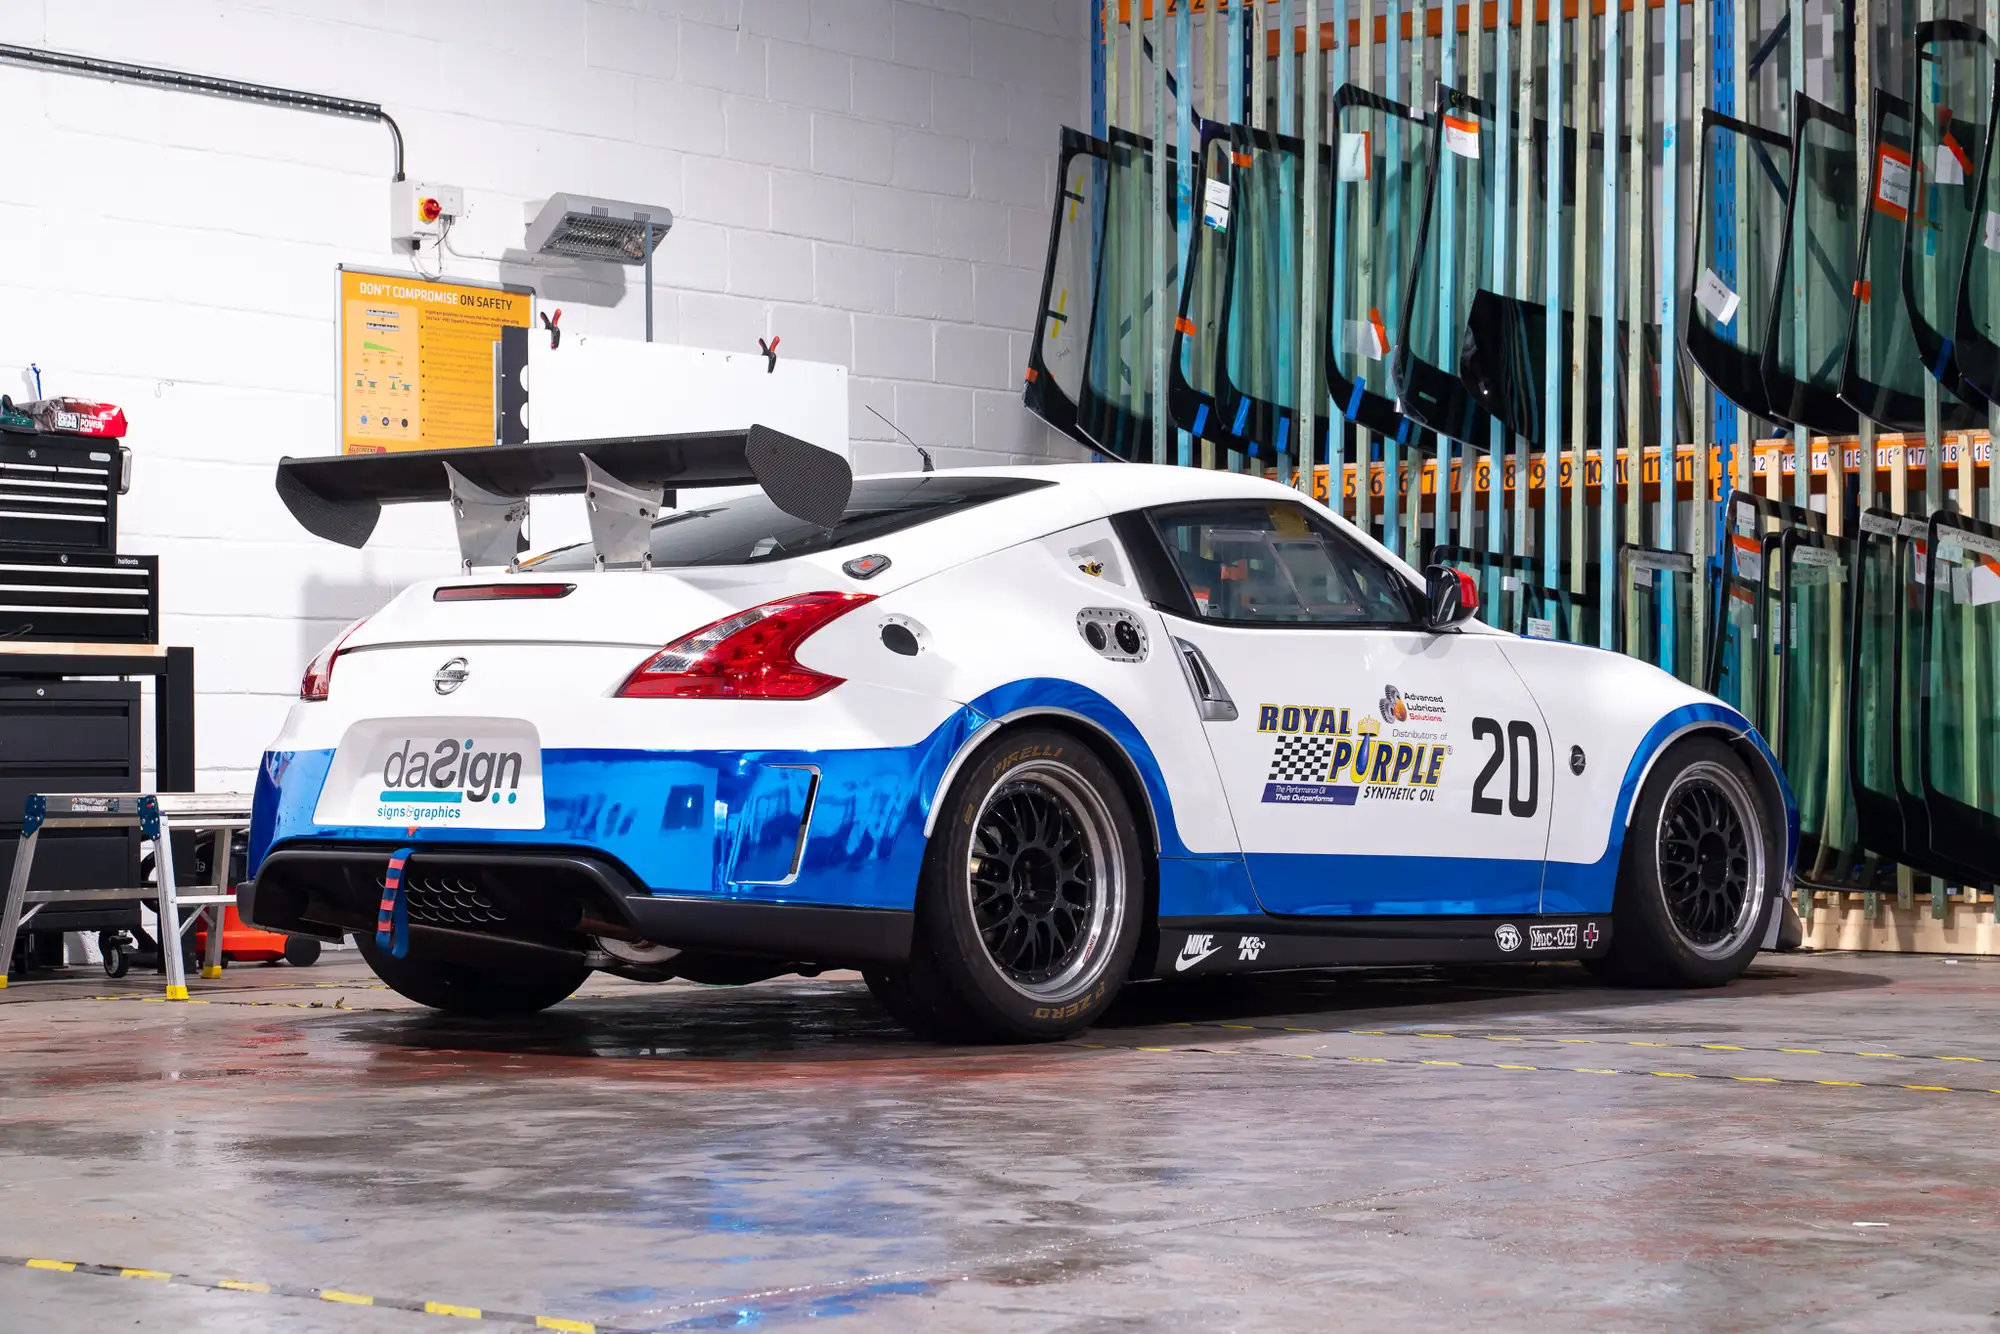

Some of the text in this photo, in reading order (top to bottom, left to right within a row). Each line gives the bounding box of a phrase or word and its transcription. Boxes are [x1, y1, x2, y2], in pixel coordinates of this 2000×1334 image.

[359, 281, 513, 311] DON'T COMPROMISE ON SAFETY
[1752, 455, 1766, 471] 12
[1813, 453, 1828, 469] 14
[1846, 450, 1861, 467] 15
[1908, 448, 1926, 464] 17
[1941, 445, 1958, 461] 18
[1975, 444, 1991, 460] 19
[1317, 475, 1327, 500] 5
[1345, 473, 1356, 499] 5
[1370, 471, 1383, 495] 6
[1423, 469, 1435, 494] 7
[1478, 465, 1490, 490] 8
[1505, 463, 1516, 489] 8
[1533, 463, 1545, 489] 9
[1560, 461, 1573, 486] 9
[1584, 459, 1601, 484] 10
[117, 557, 139, 565] halfords
[1404, 692, 1444, 703] Advanced
[1406, 702, 1447, 713] Lubricant
[1257, 703, 1353, 737] ROYAL
[1409, 712, 1443, 722] Solutions
[1392, 728, 1448, 741] Distributors of
[992, 744, 1064, 781] PIRELLI
[1326, 738, 1447, 788] PURPLE
[1471, 716, 1539, 818] 20
[1275, 784, 1286, 793] The
[1286, 785, 1319, 795] Performance
[1275, 793, 1334, 803] That Outperforms
[1363, 785, 1435, 802] SYNTHETIC OIL
[1183, 934, 1214, 955] NIKE
[1531, 927, 1576, 947] Muc-Off
[1034, 993, 1092, 1019] ZERO
